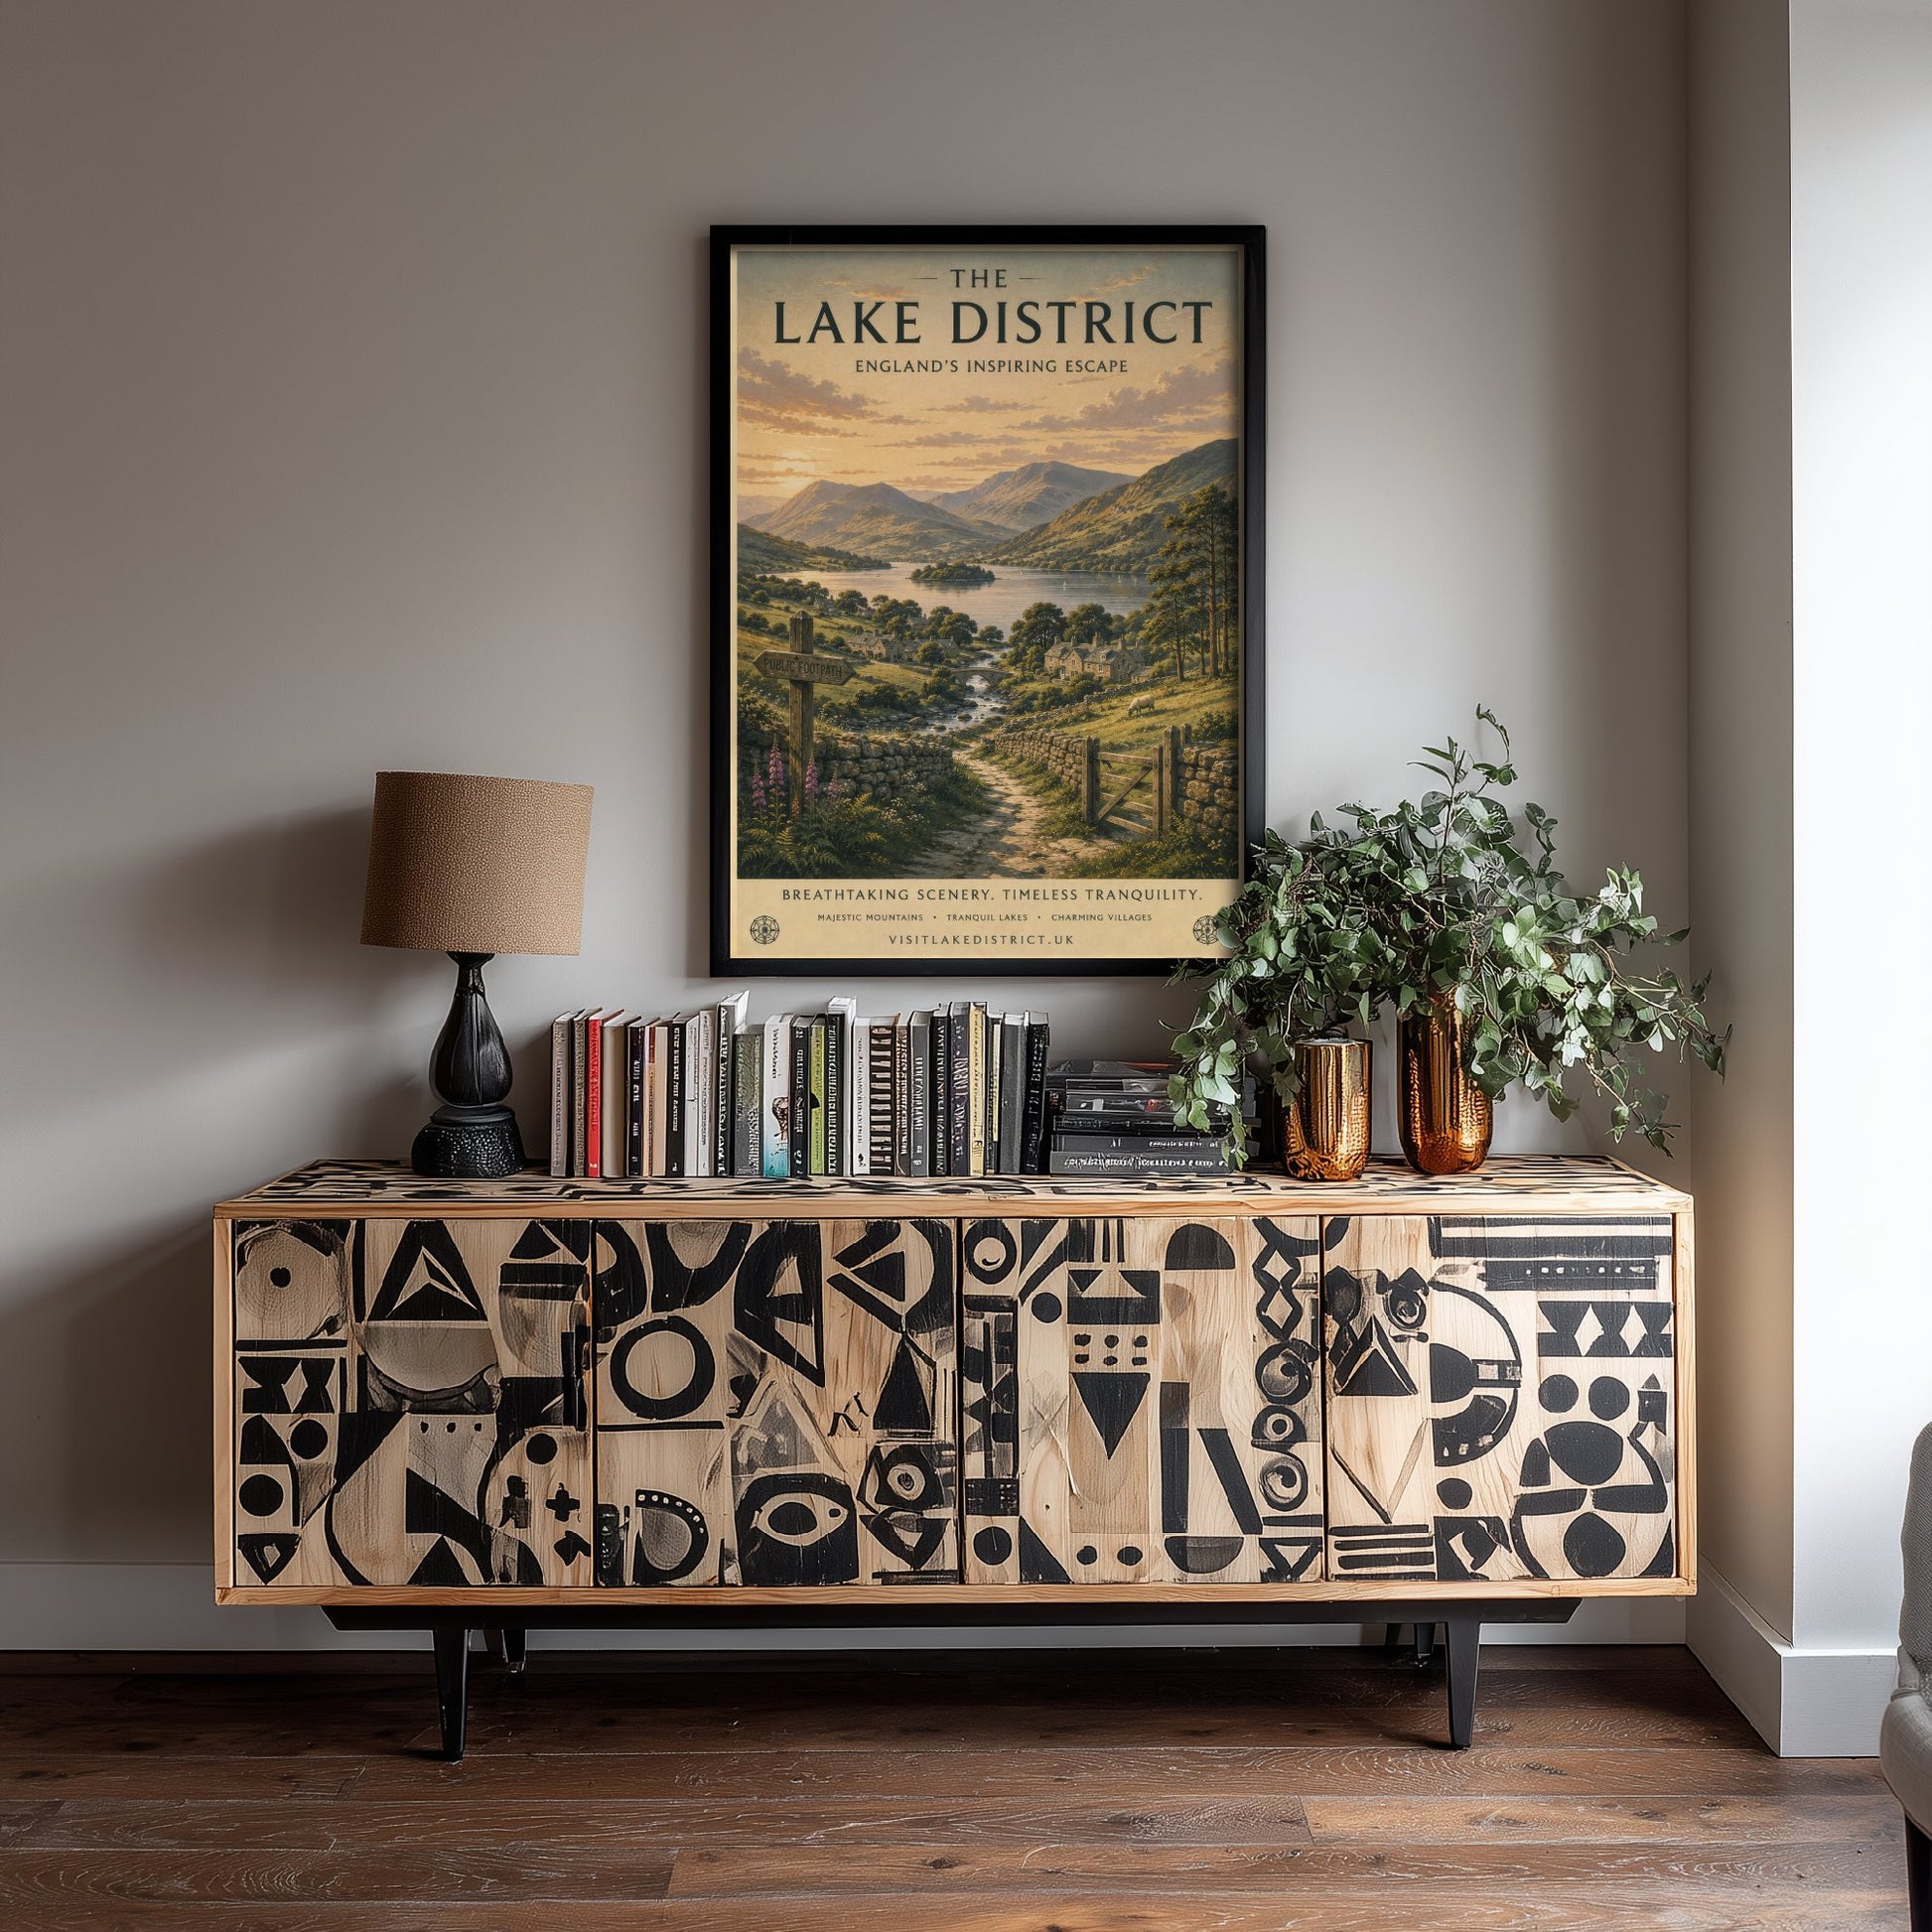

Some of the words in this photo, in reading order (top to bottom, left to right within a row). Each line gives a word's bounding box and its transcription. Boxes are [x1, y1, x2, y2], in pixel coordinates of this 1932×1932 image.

[950, 269, 1008, 288] THE
[774, 301, 921, 345] LAKE
[950, 300, 1213, 345] DISTRICT
[856, 359, 959, 373] ENGLAND'S
[967, 359, 1057, 373] INSPIRING
[1065, 359, 1129, 373] ESCAPE
[763, 657, 795, 672] PUBLIC
[797, 660, 842, 677] FOOTPATH
[782, 889, 909, 900] BREATHTAKING
[916, 889, 995, 900] SCENERY.
[1003, 889, 1078, 900] TIMELESS
[1084, 889, 1203, 902] TRANQUILITY.
[817, 913, 862, 922] MAJESTIC
[946, 913, 996, 922] TRANQUIL
[889, 935, 1074, 945] VISITLAKEDISTRICT.UK
